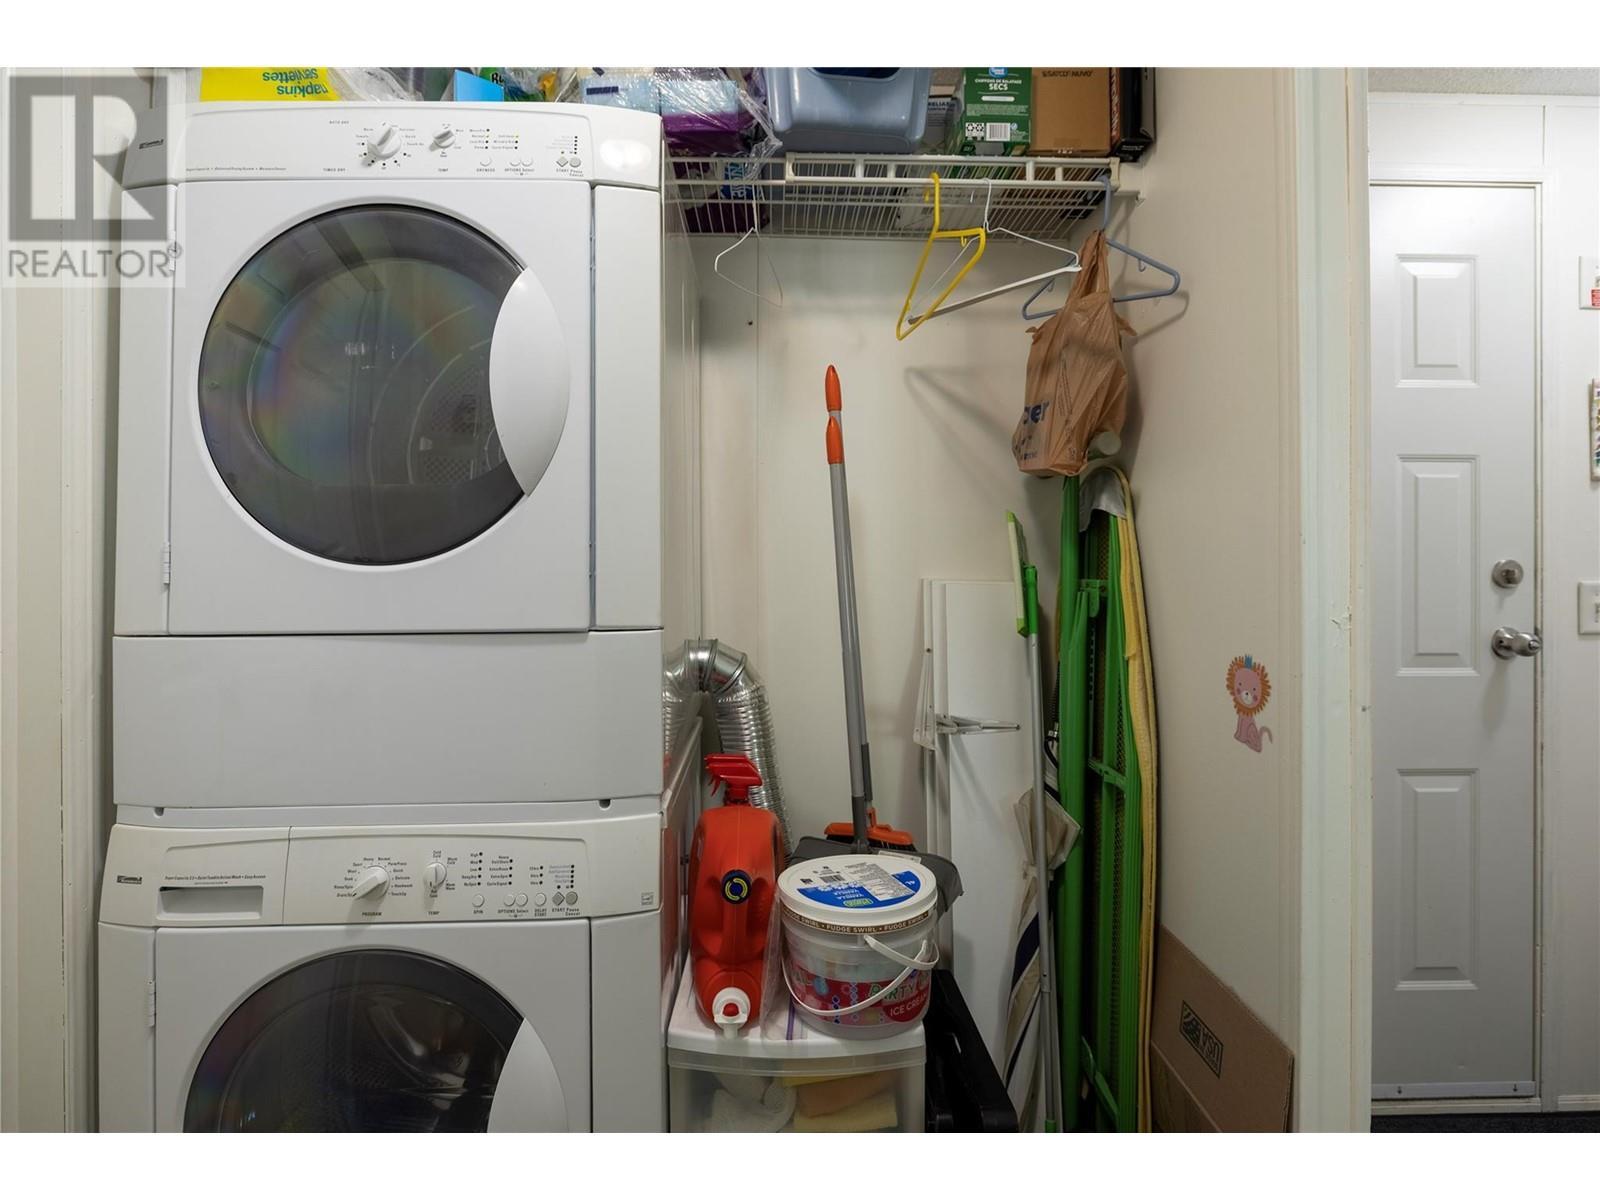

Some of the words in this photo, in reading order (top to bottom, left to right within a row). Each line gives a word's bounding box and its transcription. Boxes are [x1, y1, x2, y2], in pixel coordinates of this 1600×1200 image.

[262, 68, 319, 83] serviettes
[277, 81, 328, 98] napkins
[989, 83, 1009, 91] SECS
[826, 924, 851, 932] FUDGE
[853, 925, 877, 933] SWIRL
[884, 922, 906, 931] FUDGE
[890, 1005, 905, 1017] ICE
